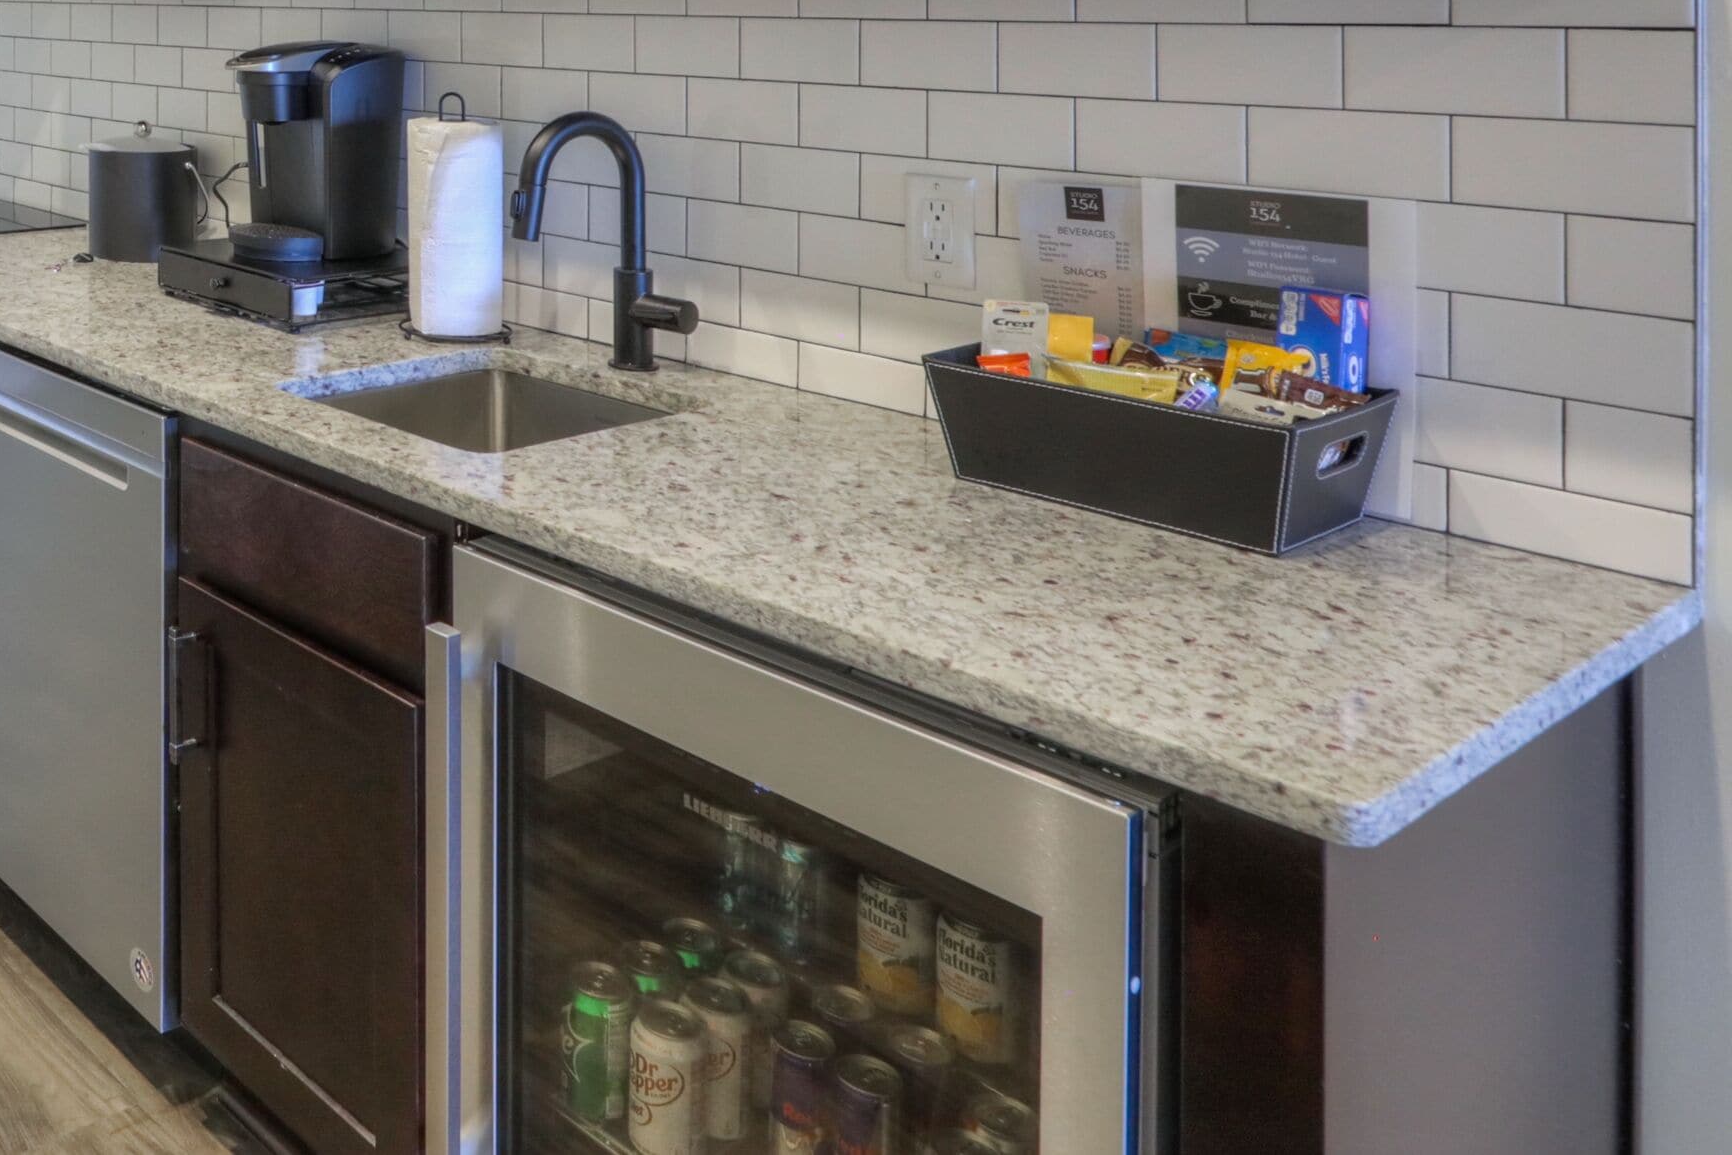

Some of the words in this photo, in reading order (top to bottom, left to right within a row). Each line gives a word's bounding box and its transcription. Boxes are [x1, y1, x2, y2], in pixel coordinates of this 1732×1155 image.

[1069, 191, 1098, 199] STUDIO
[1071, 198, 1098, 211] 154
[1249, 200, 1281, 210] STUDIO
[1249, 207, 1281, 222] 154
[1057, 226, 1116, 239] BEVERAGES
[1063, 266, 1108, 279] SNACKS
[1250, 310, 1266, 320] Bar
[992, 318, 1035, 328] Crest
[635, 1053, 659, 1077] Dr
